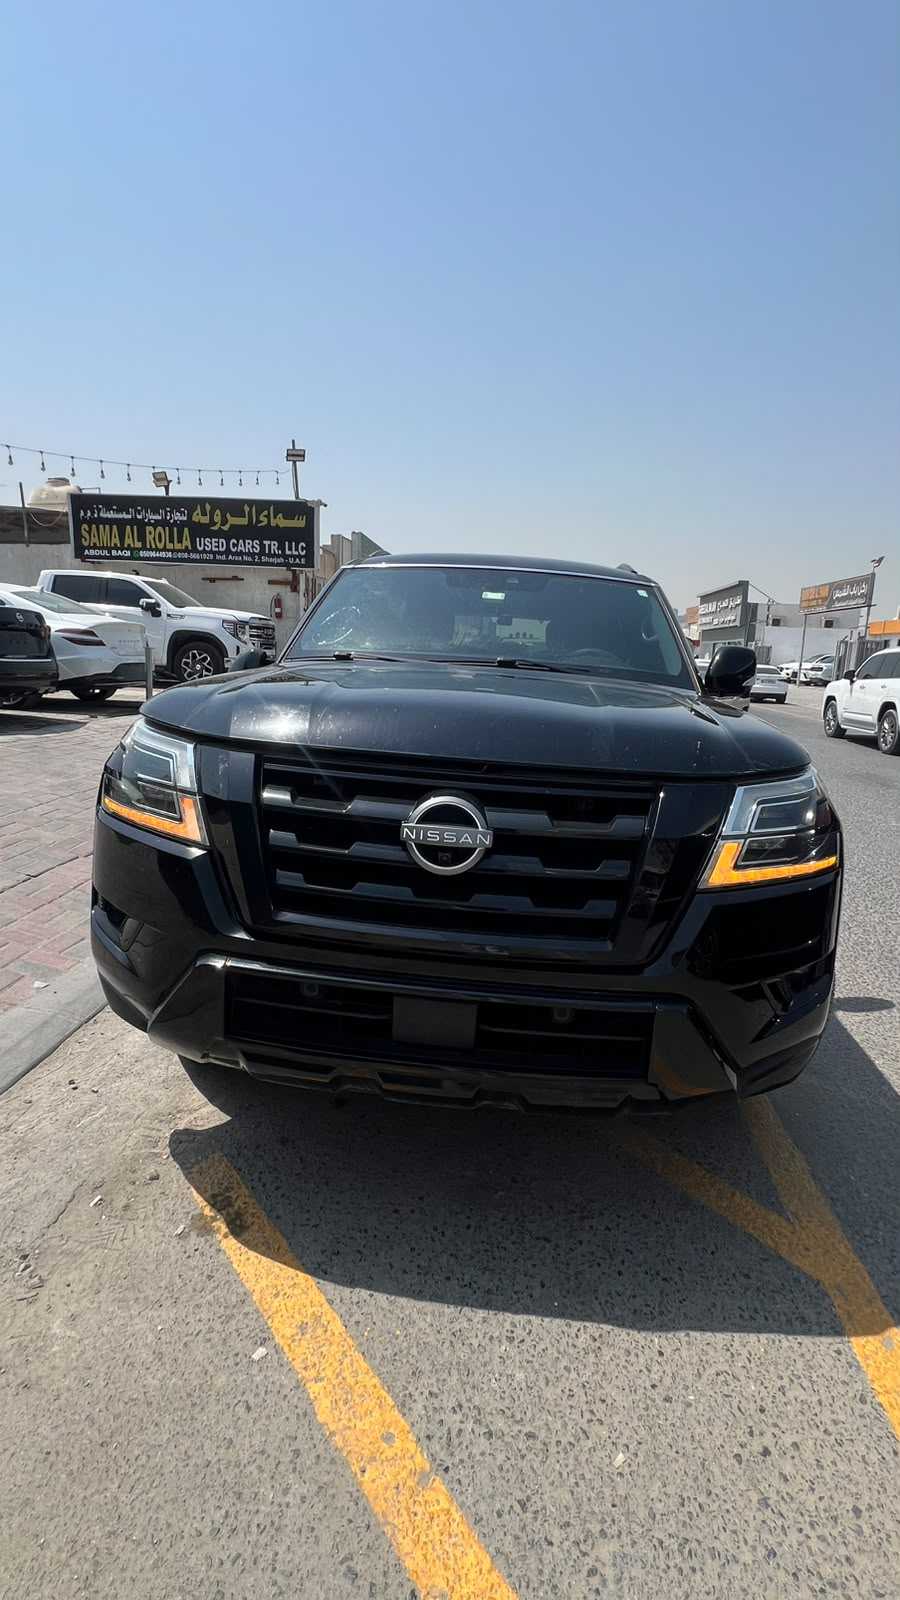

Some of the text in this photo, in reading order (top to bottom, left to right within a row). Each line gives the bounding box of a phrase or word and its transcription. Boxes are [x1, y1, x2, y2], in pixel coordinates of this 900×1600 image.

[98, 504, 135, 519] المستعملة
[136, 506, 165, 523] السيارات
[165, 507, 188, 523] لتجارة
[257, 504, 306, 528] سماء
[81, 523, 306, 556] SAMA AL ROLLA USED CARS TR. LLC
[84, 549, 110, 557] ABDUL
[111, 549, 131, 557] BAQI
[402, 827, 490, 846] NISSAN
